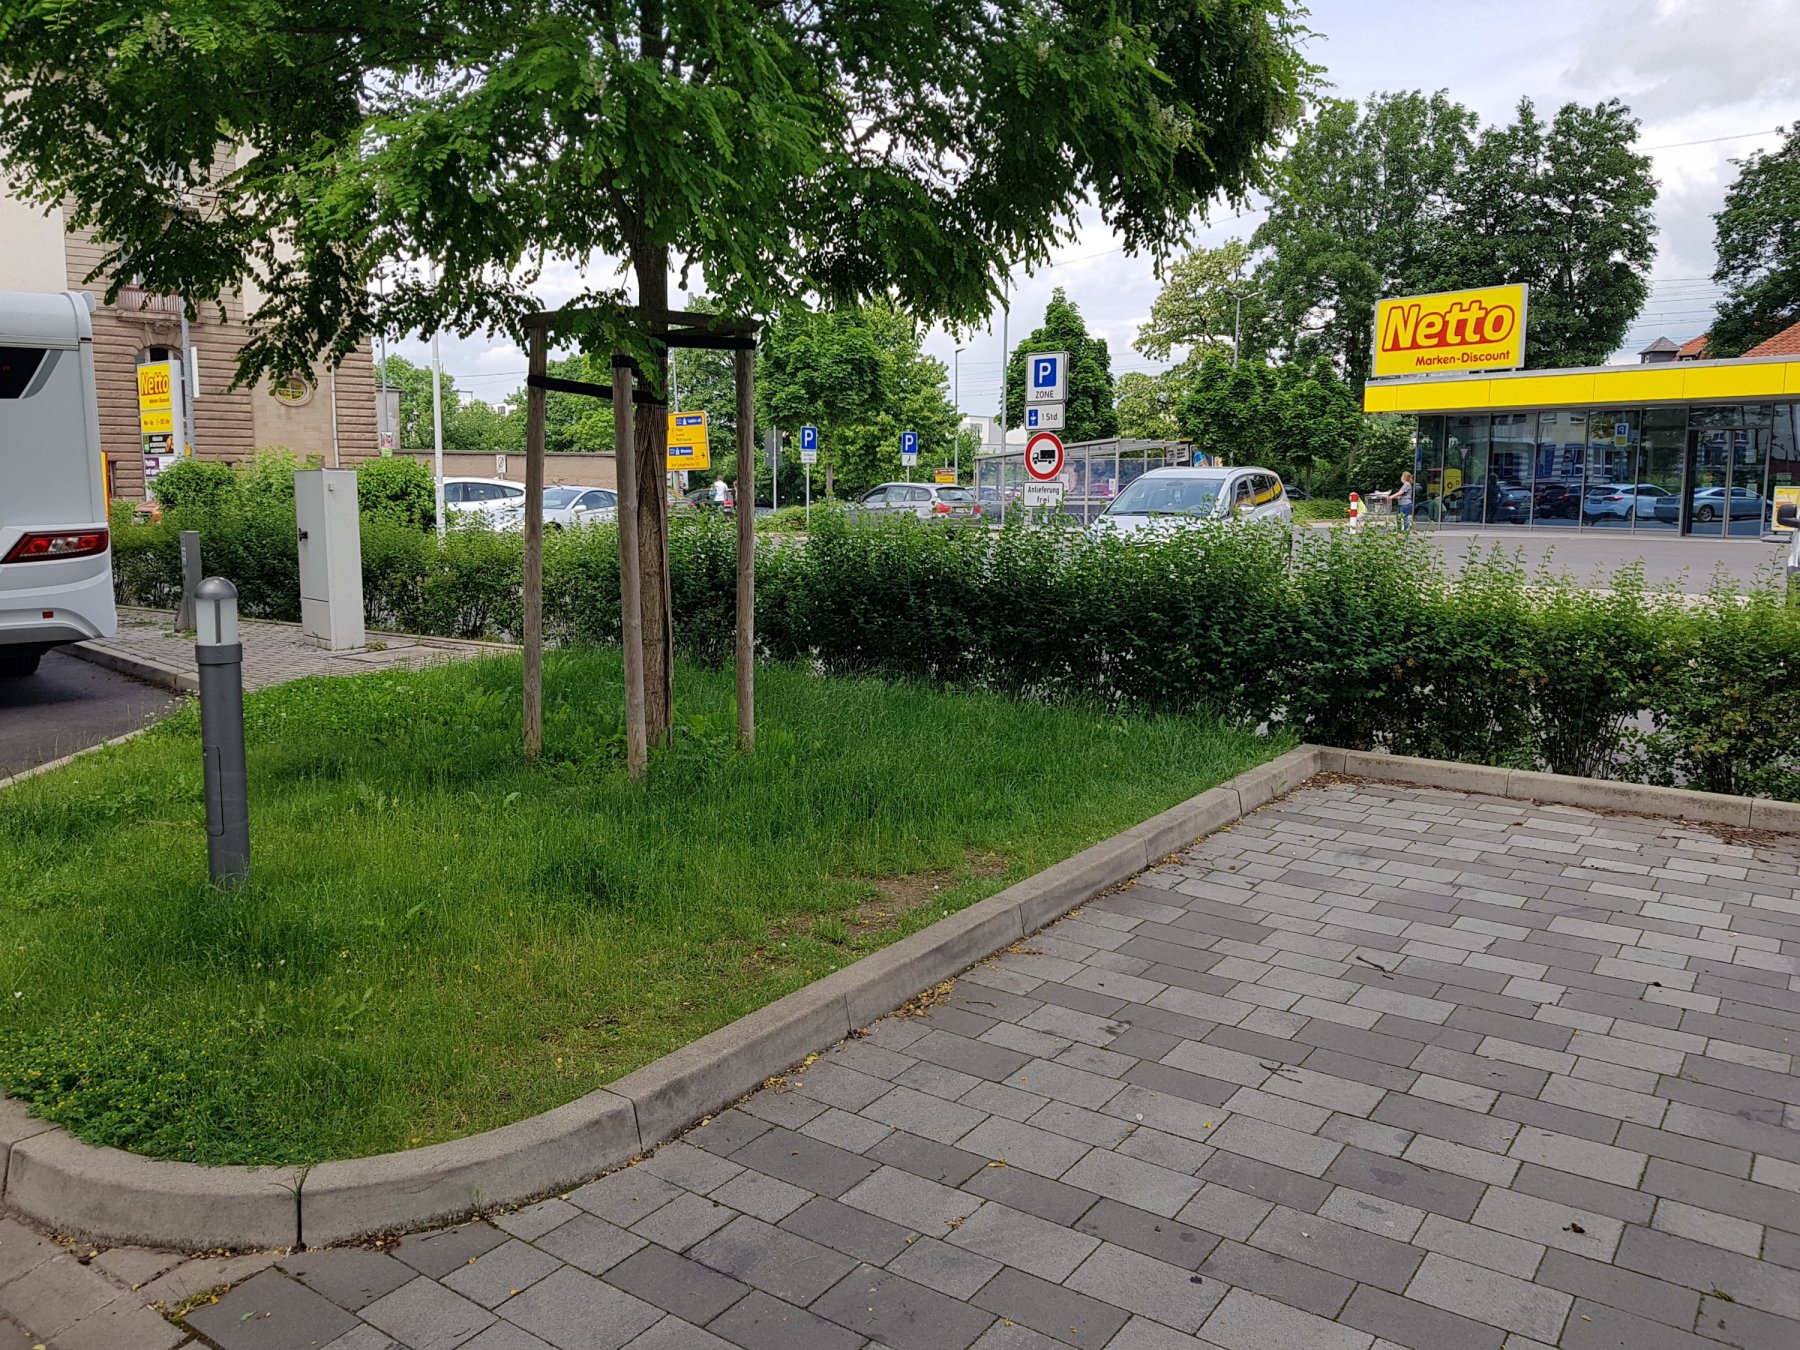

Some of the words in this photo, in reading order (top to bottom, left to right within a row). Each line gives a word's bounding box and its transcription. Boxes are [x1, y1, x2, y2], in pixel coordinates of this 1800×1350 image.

[1382, 300, 1515, 352] Netto
[1415, 350, 1510, 366] Marken-Discount
[1039, 362, 1051, 384] P
[141, 372, 169, 396] Netto
[1035, 390, 1054, 399] ZONE
[1042, 413, 1045, 421] 1
[804, 429, 814, 447] P
[905, 434, 914, 451] P
[1027, 485, 1060, 495] Anlieferung
